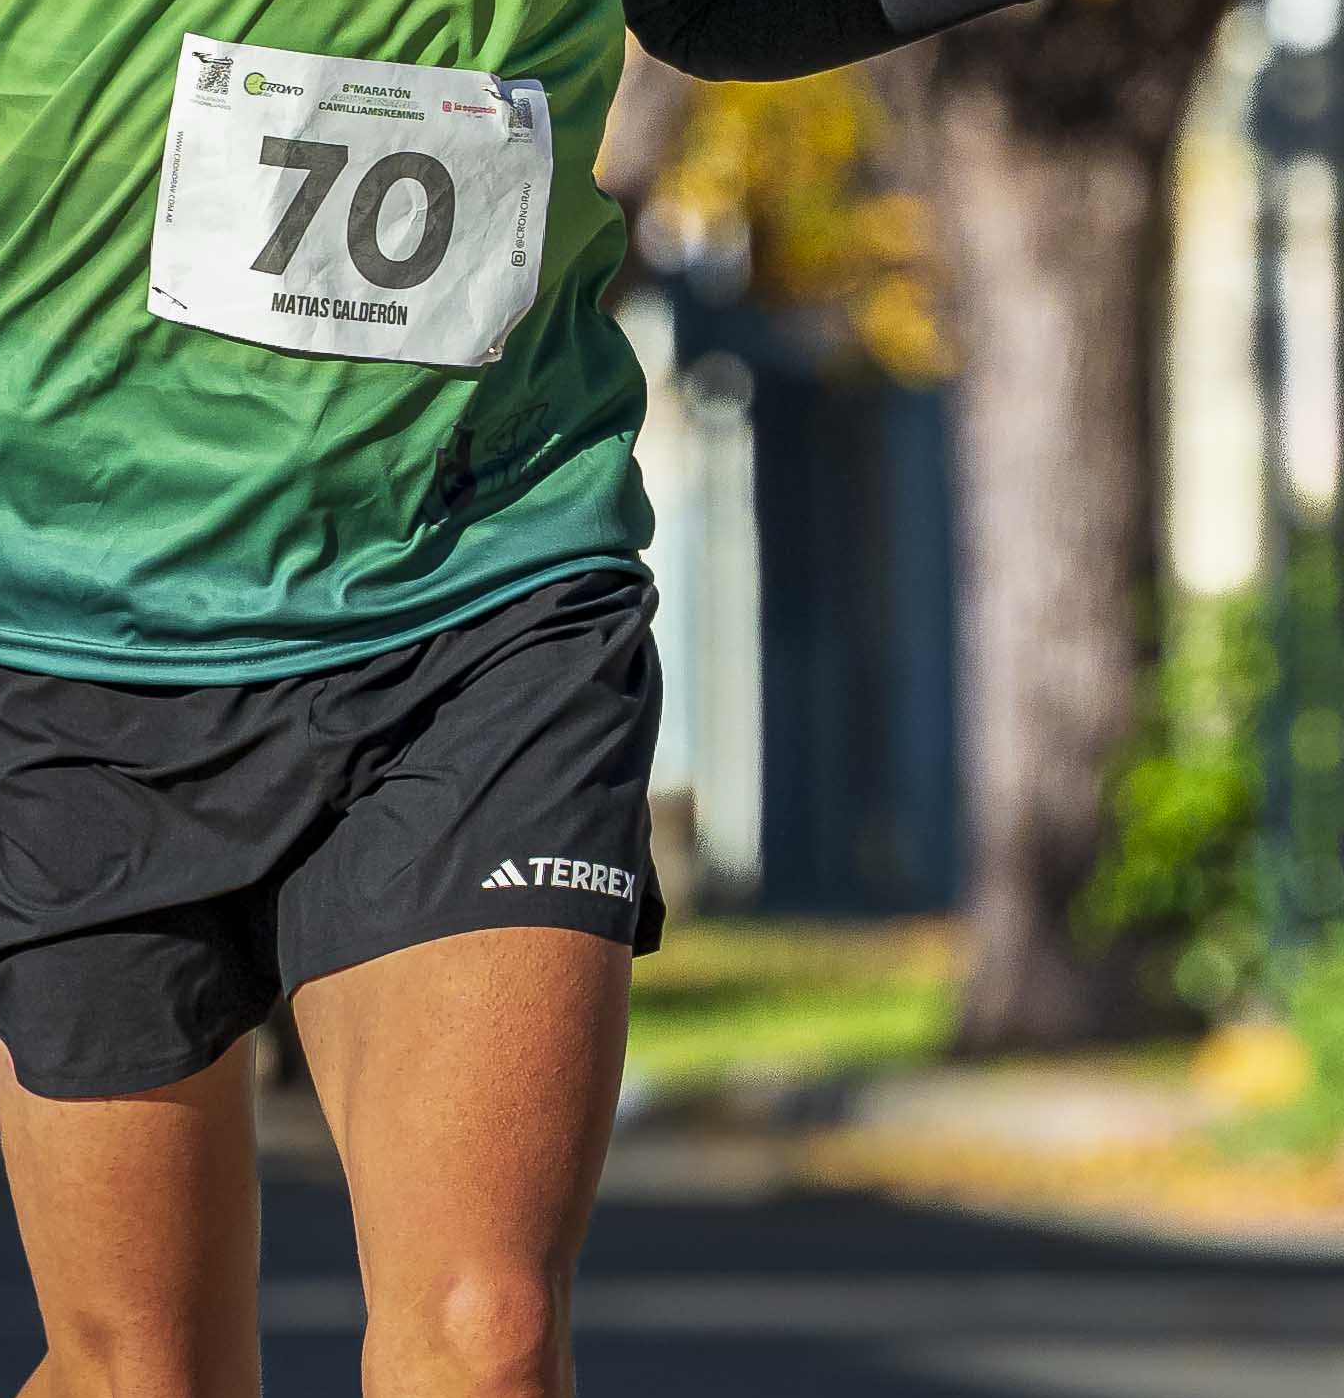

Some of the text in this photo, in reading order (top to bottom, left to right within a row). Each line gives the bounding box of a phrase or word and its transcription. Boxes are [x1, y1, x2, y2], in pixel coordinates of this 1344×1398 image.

[250, 135, 455, 290] 70
[271, 293, 408, 326] MATIAS CALDERÓN
[528, 857, 636, 903] TERREX
